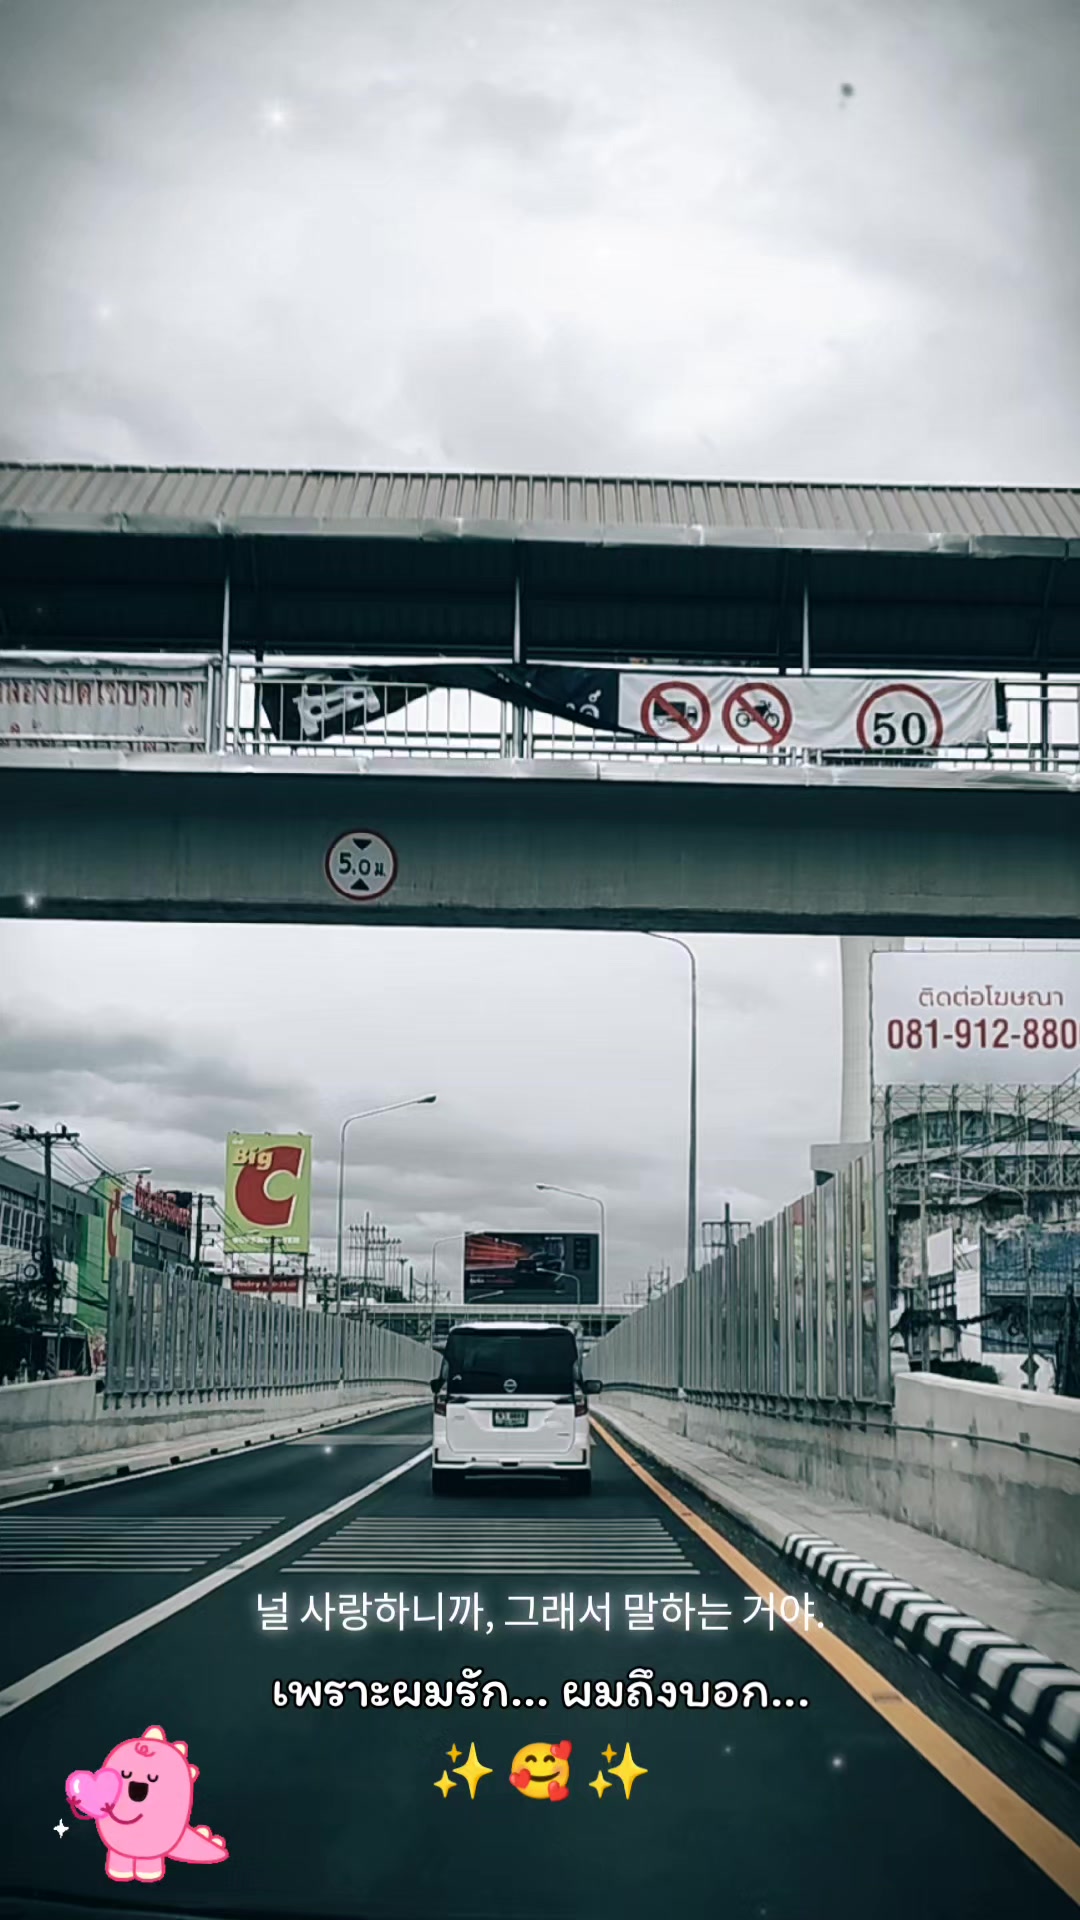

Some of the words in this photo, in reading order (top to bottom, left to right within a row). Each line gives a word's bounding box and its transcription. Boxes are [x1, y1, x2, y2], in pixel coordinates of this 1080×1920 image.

[873, 712, 926, 747] 50
[918, 985, 1064, 1008] ติดต่อโฆษณา
[887, 1018, 1080, 1050] 081-912-880
[231, 1146, 274, 1171] Big
[234, 1145, 305, 1228] C
